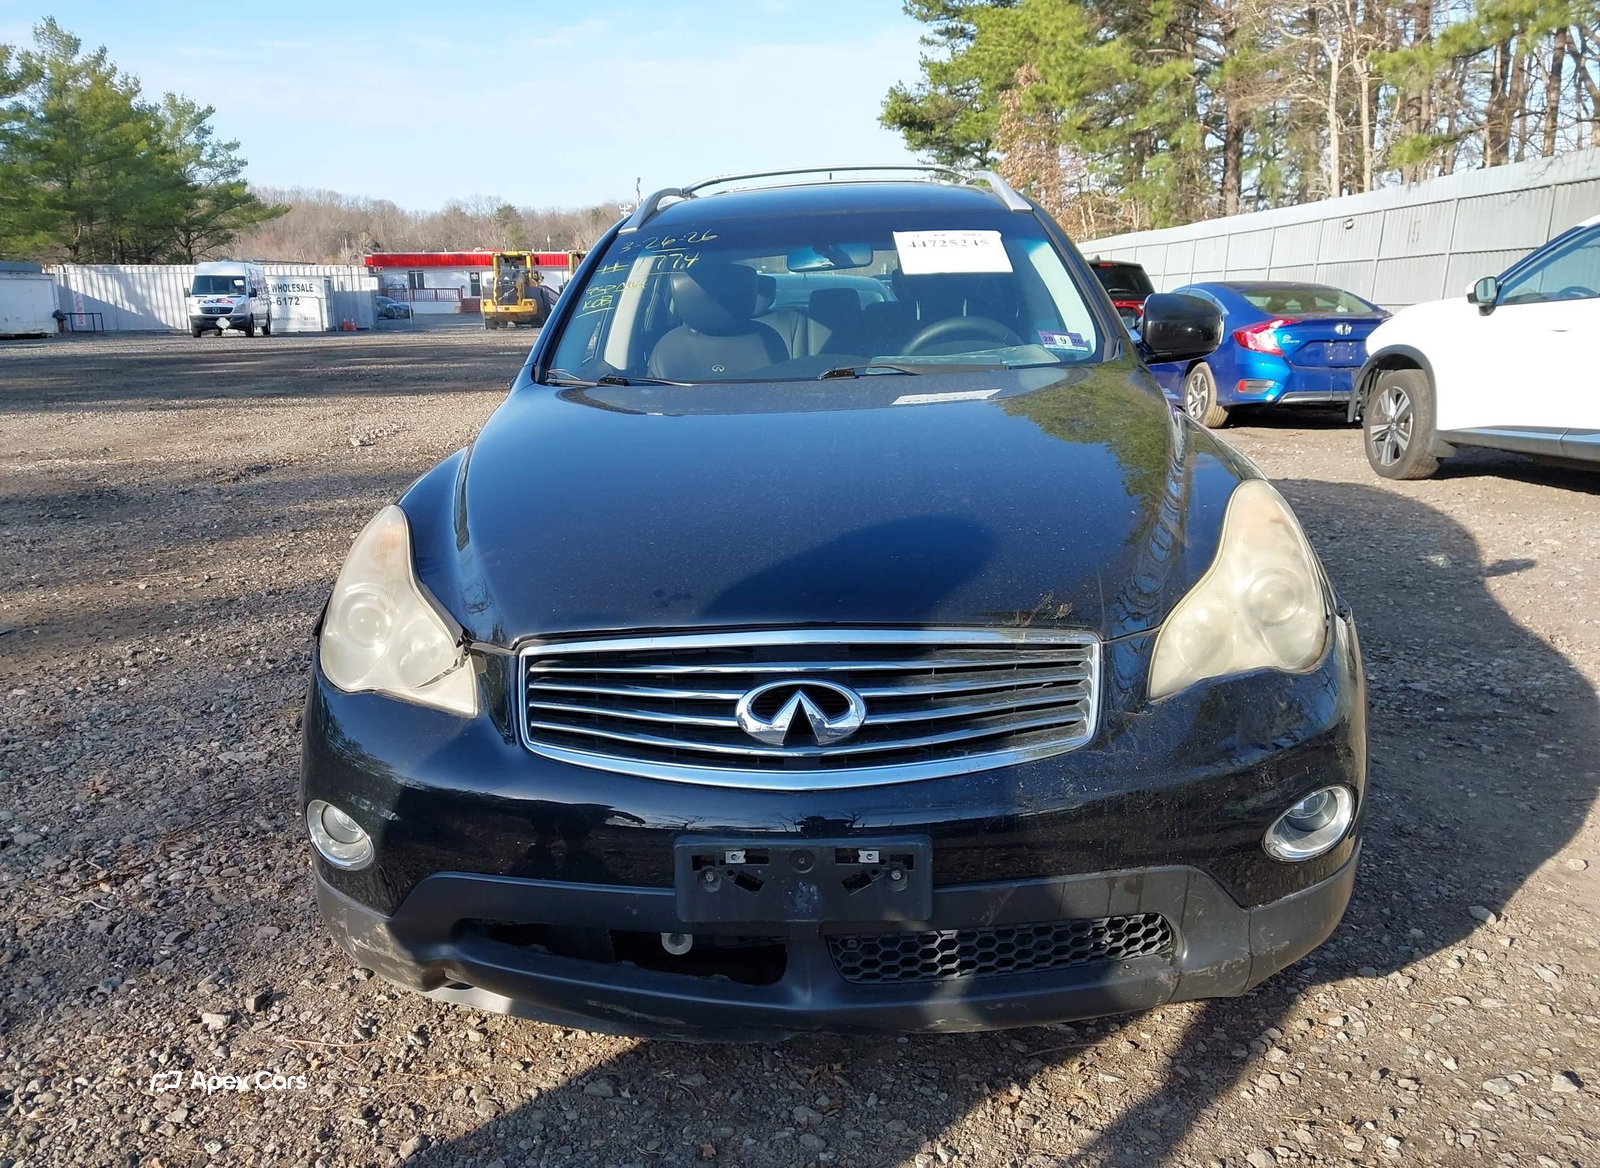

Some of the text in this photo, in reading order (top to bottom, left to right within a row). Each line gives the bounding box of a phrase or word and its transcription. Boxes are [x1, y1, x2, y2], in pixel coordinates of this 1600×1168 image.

[619, 229, 718, 254] 3-26-26
[907, 239, 989, 248] 44725245
[271, 283, 314, 293] WHOLESALE
